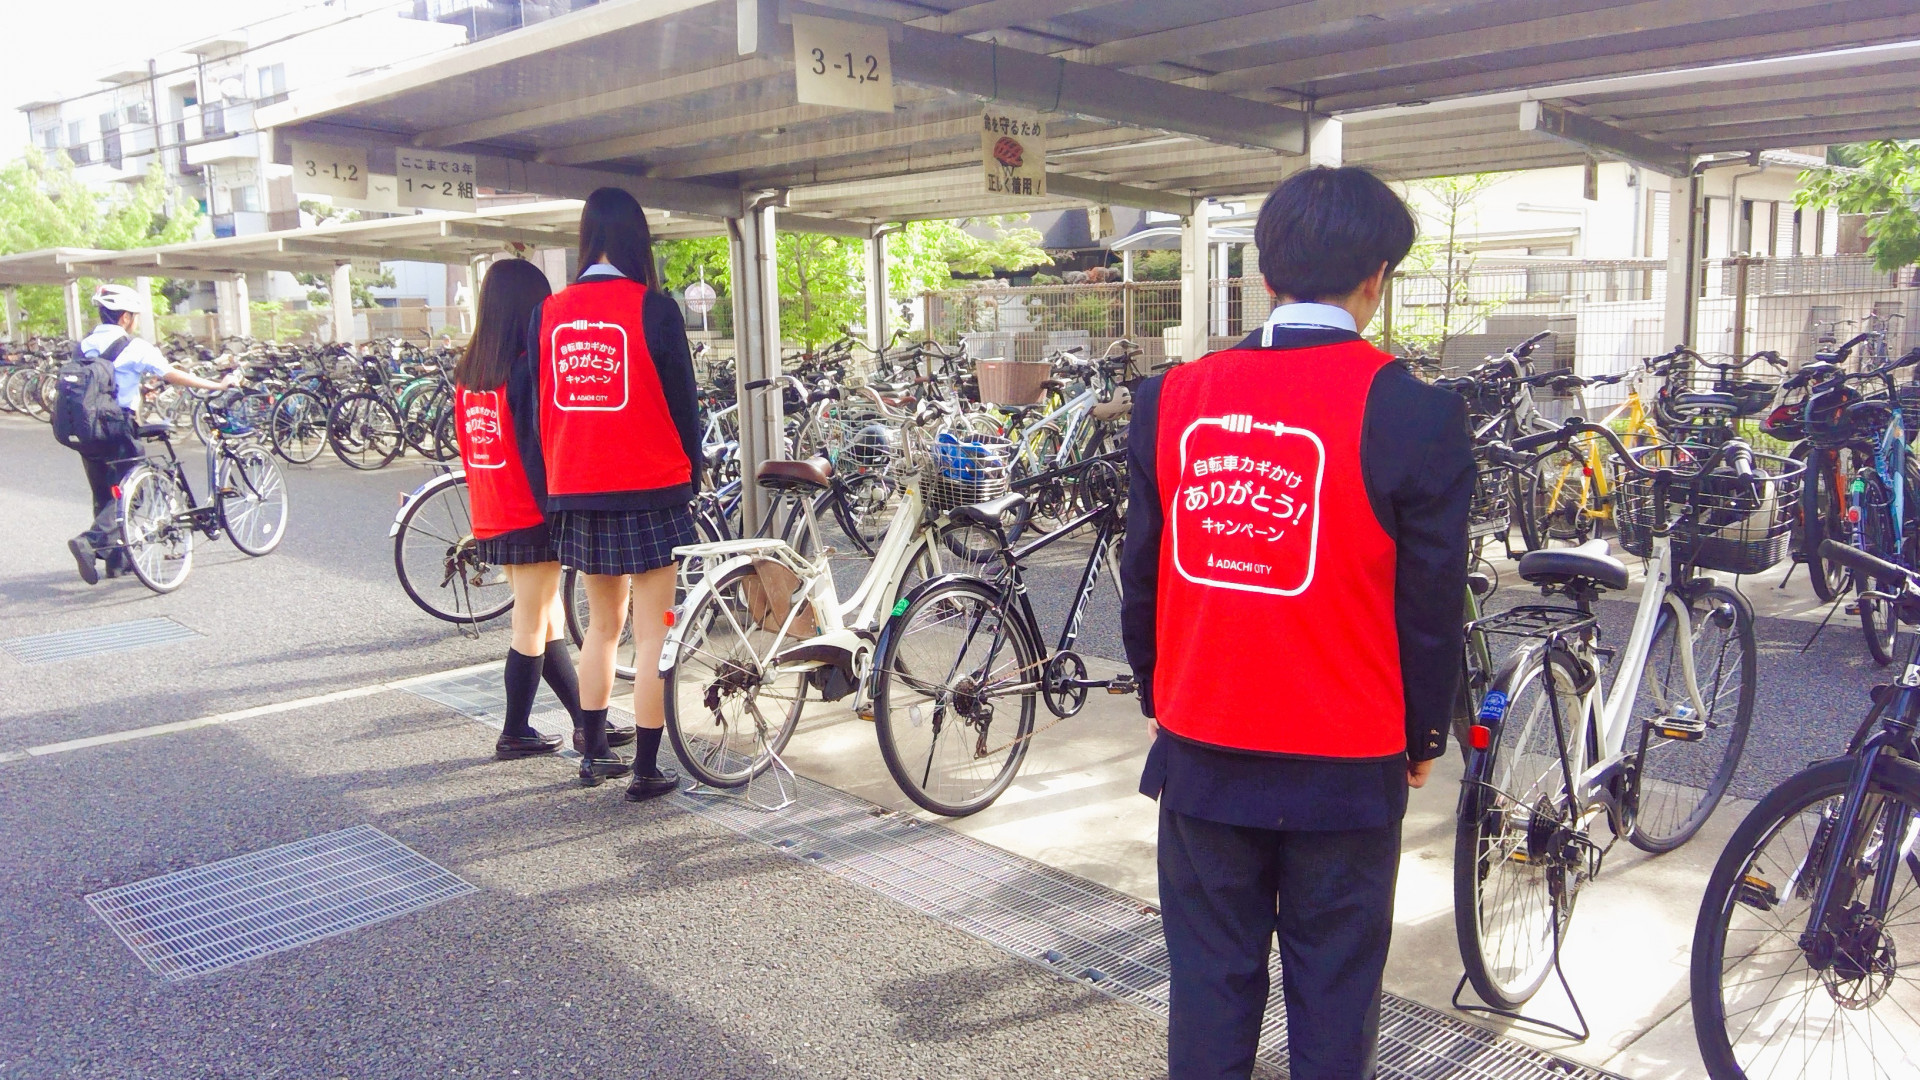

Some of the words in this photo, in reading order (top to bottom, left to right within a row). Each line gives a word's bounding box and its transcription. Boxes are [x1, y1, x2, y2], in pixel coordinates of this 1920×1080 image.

[811, 48, 879, 84] 3-1,2
[983, 113, 1041, 137] 命を守るため
[305, 160, 359, 182] 3-1,2
[401, 156, 474, 176] ここまで3年
[560, 341, 617, 356] 自転車カギかけ
[558, 353, 621, 375] ありがとう!
[565, 374, 611, 384] キャンペーン
[1193, 455, 1303, 489] 自転車カギかけ
[1184, 480, 1308, 527] ありがとう!
[1201, 517, 1285, 542] キャンペーン
[1215, 559, 1253, 572] ADACHI
[1254, 563, 1273, 575] CITY
